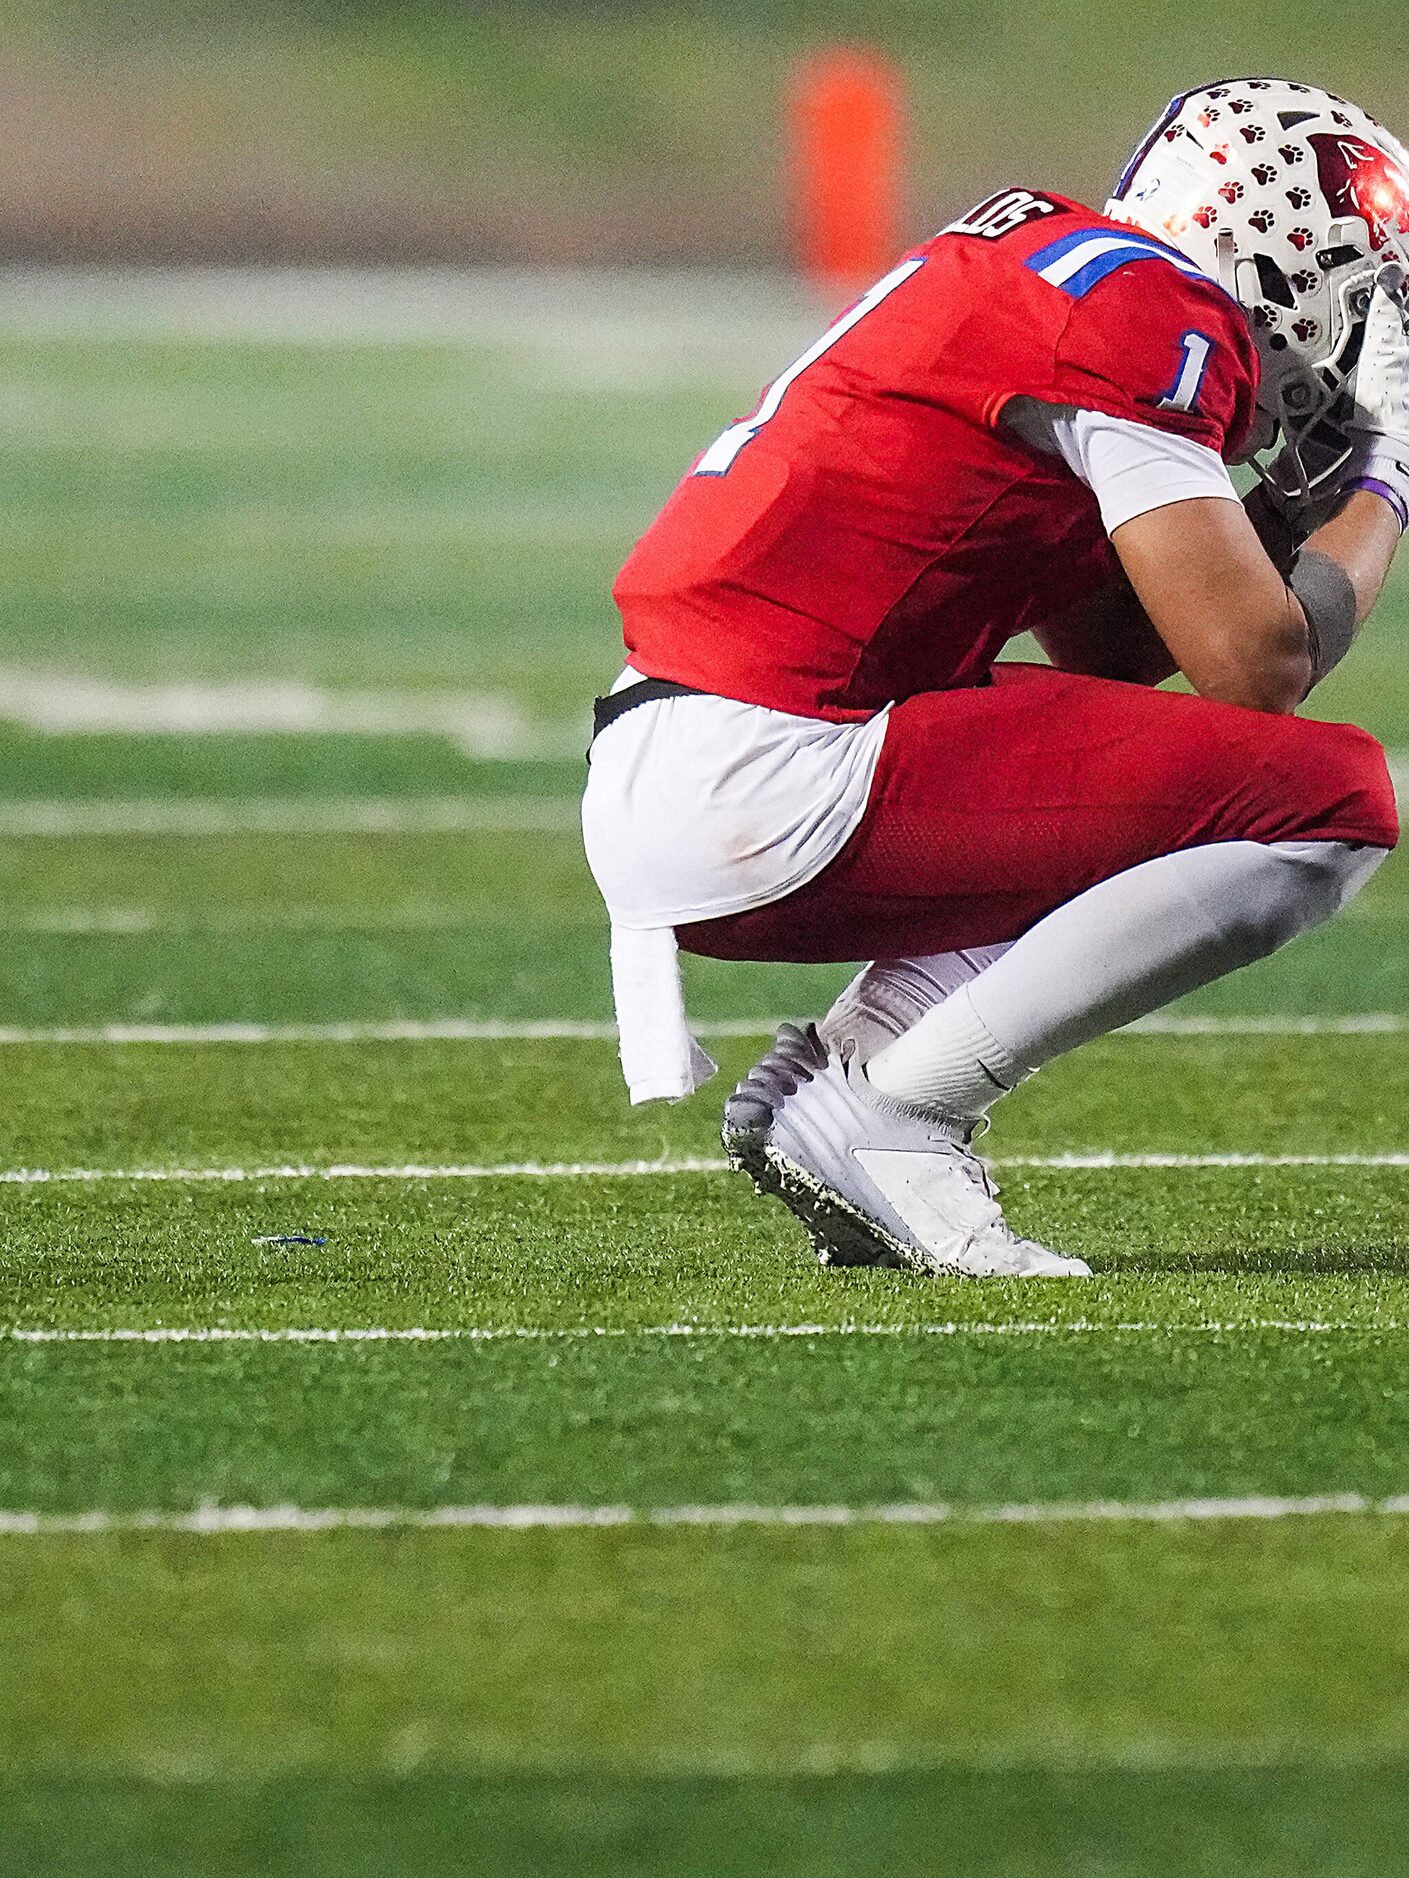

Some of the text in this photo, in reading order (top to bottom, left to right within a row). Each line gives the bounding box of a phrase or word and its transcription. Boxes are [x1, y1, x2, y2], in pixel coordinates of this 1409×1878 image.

[936, 189, 1055, 238] LDS
[693, 257, 928, 476] 1
[1154, 329, 1213, 414] 1
